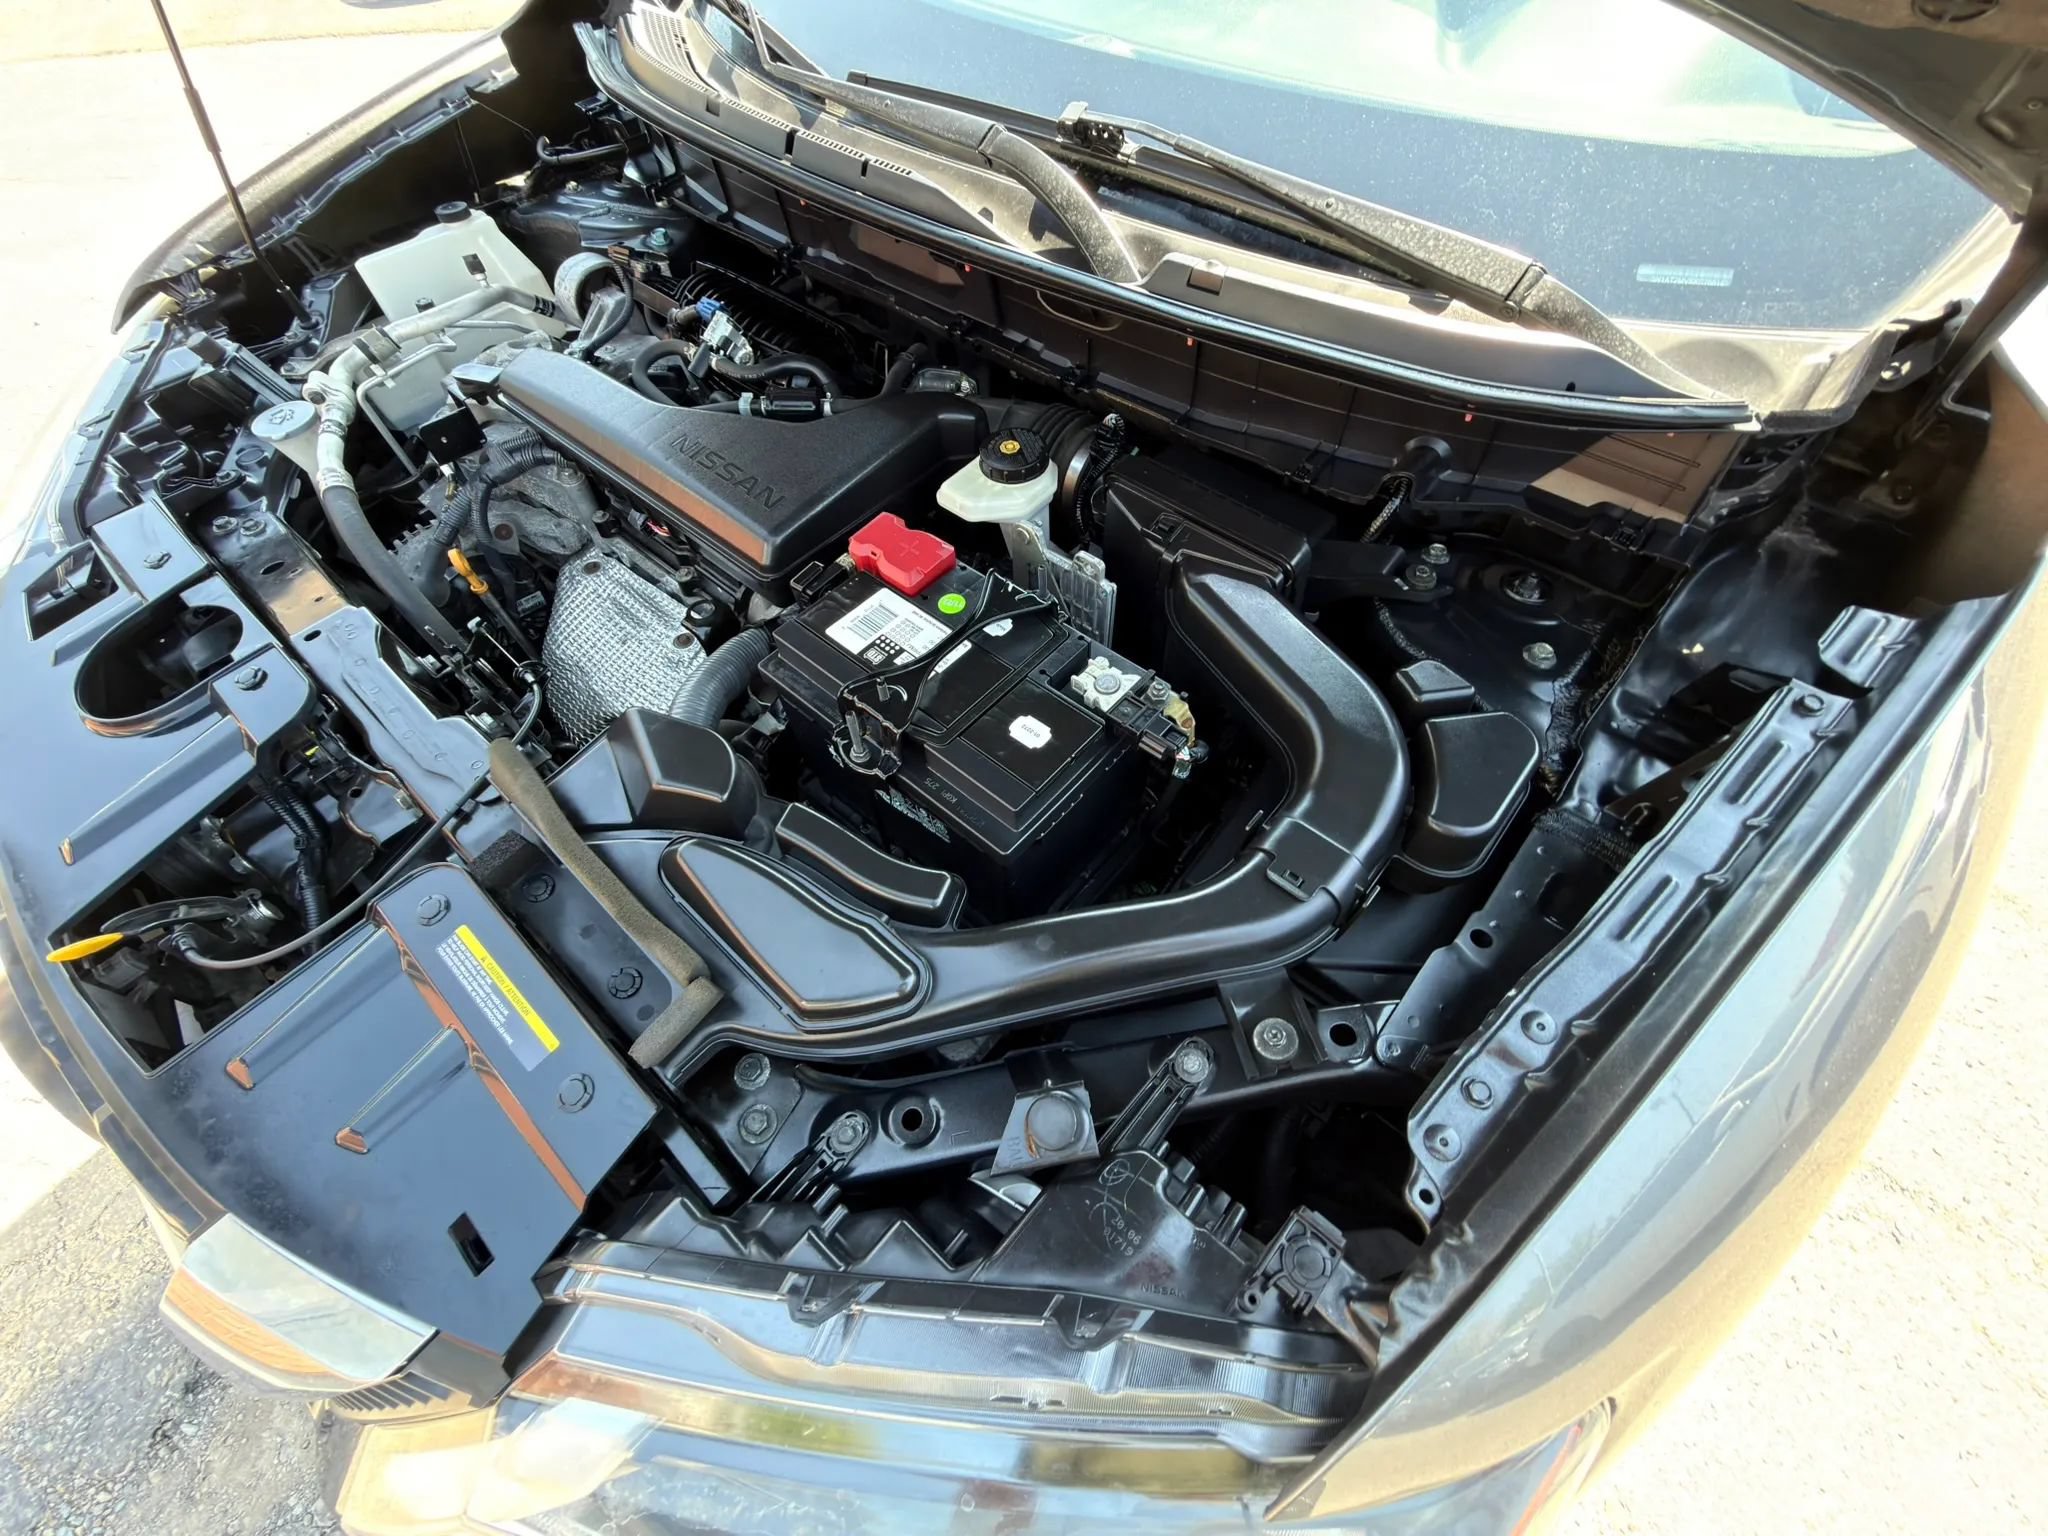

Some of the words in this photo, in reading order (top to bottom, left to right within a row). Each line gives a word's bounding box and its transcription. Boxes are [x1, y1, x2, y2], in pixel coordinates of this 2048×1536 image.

[672, 433, 785, 511] NISSAN
[485, 961, 506, 986] CAUTION
[505, 986, 531, 1017] ATTENTION
